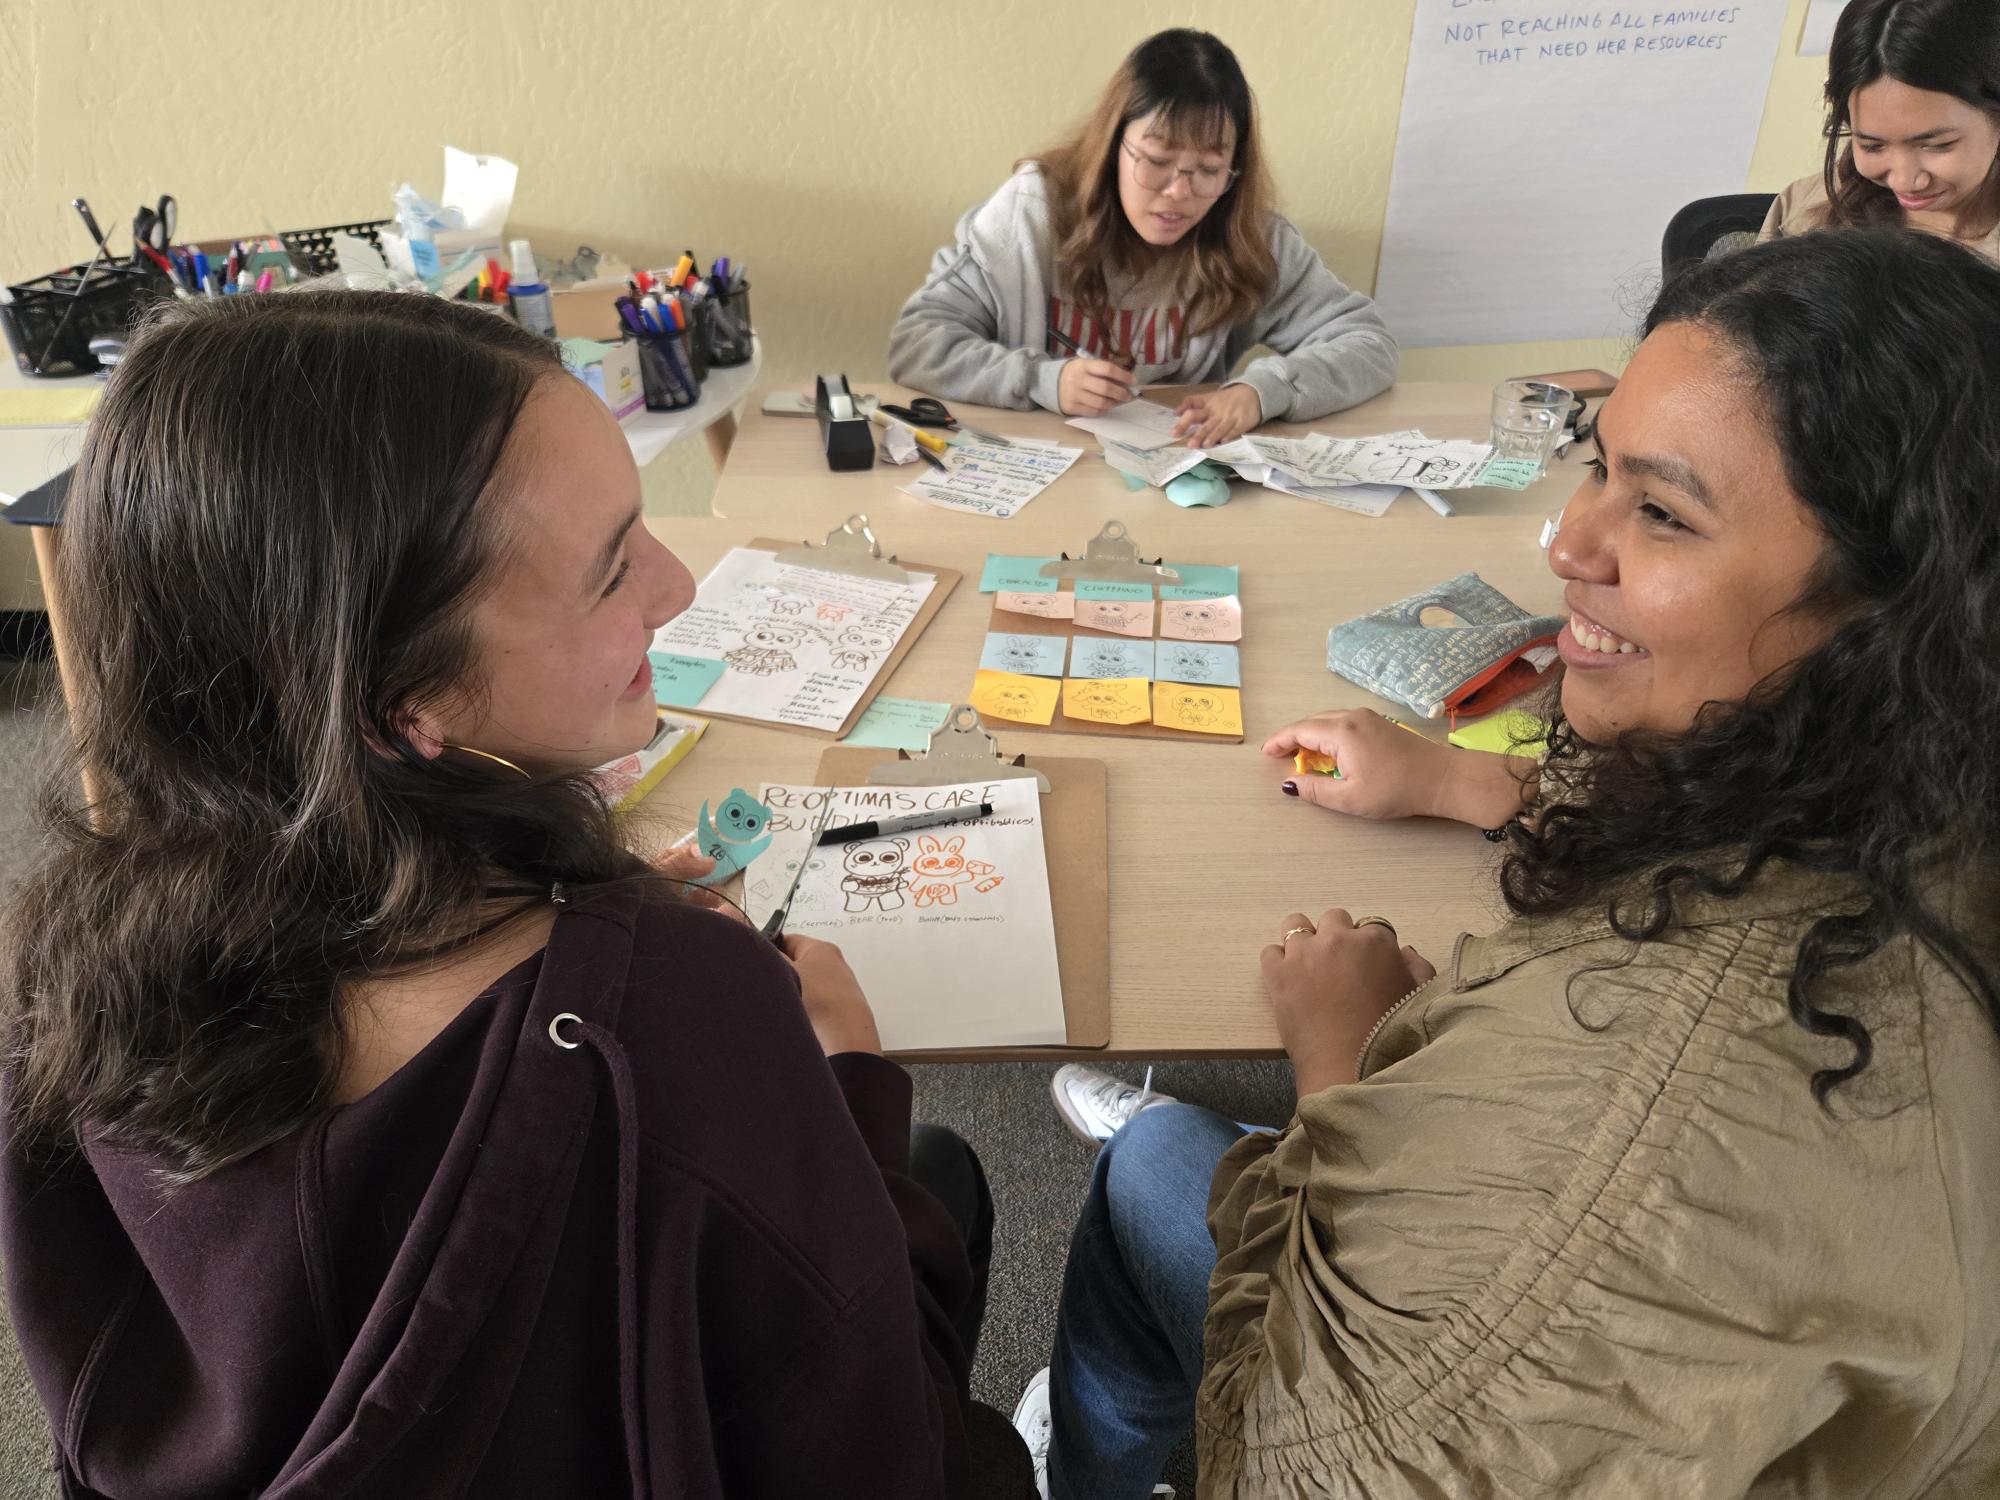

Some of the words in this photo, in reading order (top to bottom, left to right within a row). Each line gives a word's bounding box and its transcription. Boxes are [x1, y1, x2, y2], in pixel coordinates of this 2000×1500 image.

[1445, 24, 1487, 44] NOT
[1501, 13, 1601, 39] REACHING
[1610, 12, 1645, 29] ALL
[1652, 8, 1741, 28] FAMILIES
[1476, 47, 1524, 65] THAT
[1538, 41, 1588, 59] NEED
[1596, 41, 1627, 54] HER
[1634, 35, 1728, 50] RESOURCES
[924, 784, 1001, 811] CARE
